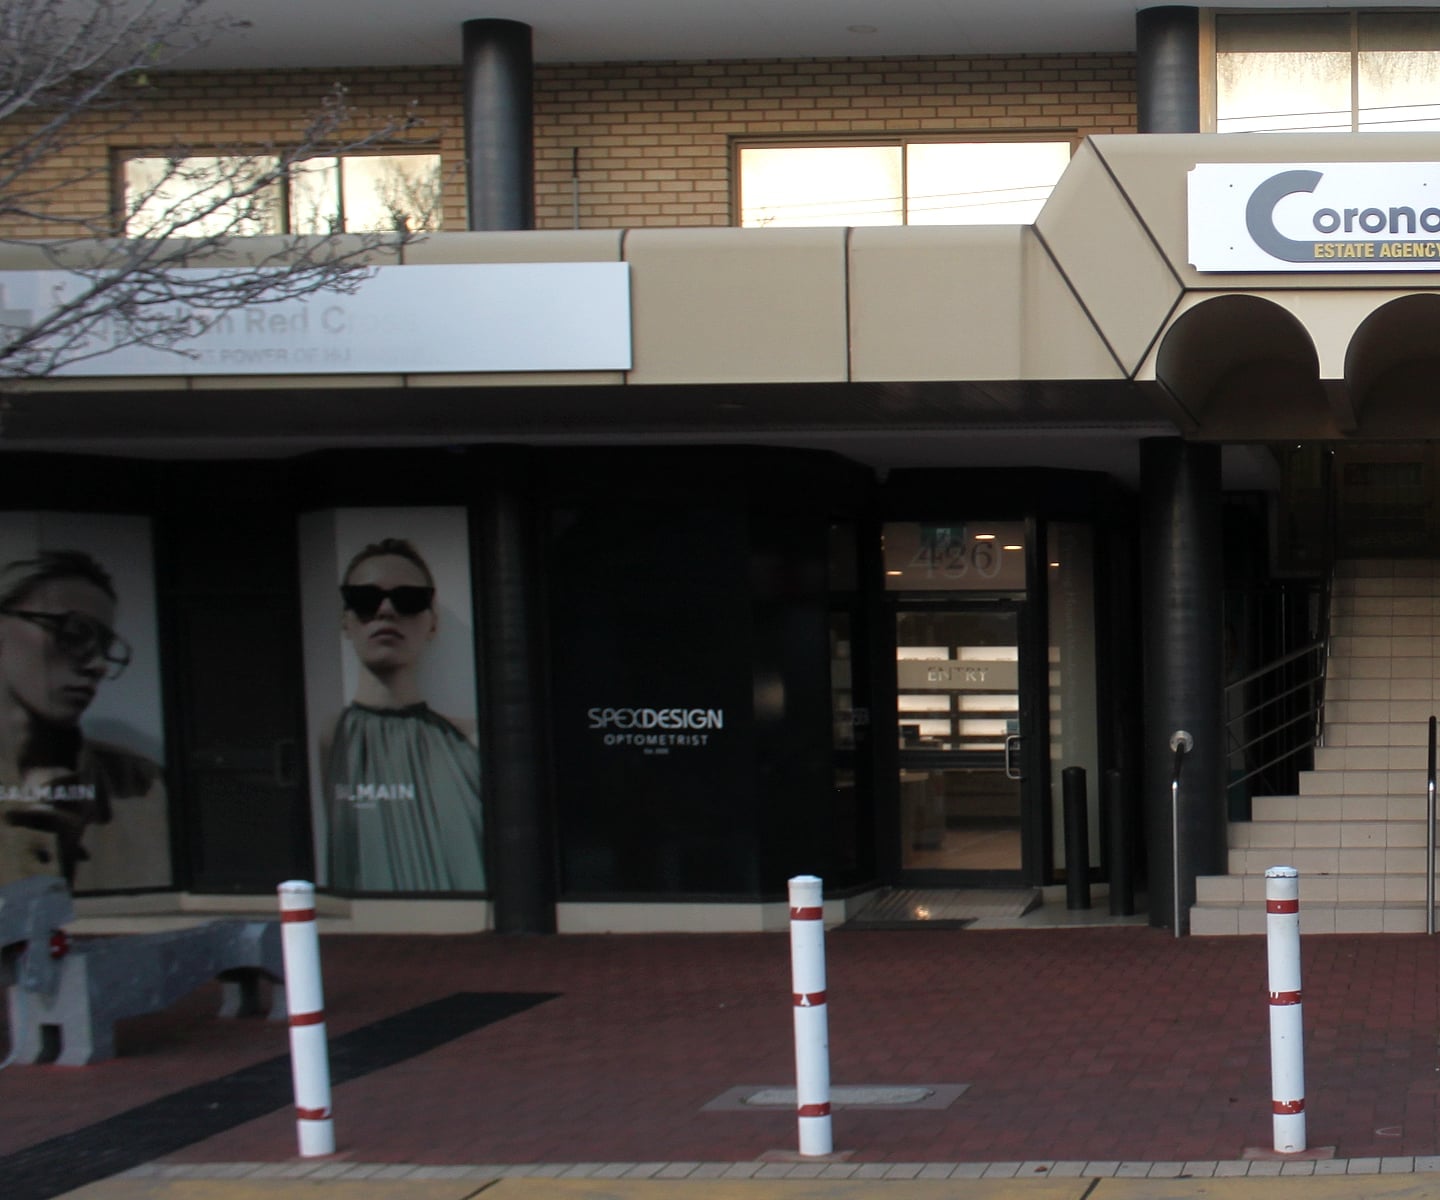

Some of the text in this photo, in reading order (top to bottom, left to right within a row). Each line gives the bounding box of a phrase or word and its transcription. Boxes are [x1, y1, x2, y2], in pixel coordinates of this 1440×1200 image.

[1314, 242, 1374, 258] ESTATE
[245, 305, 310, 336] Red
[927, 666, 989, 682] ENTRY
[603, 733, 709, 746] OPTOMETRIST
